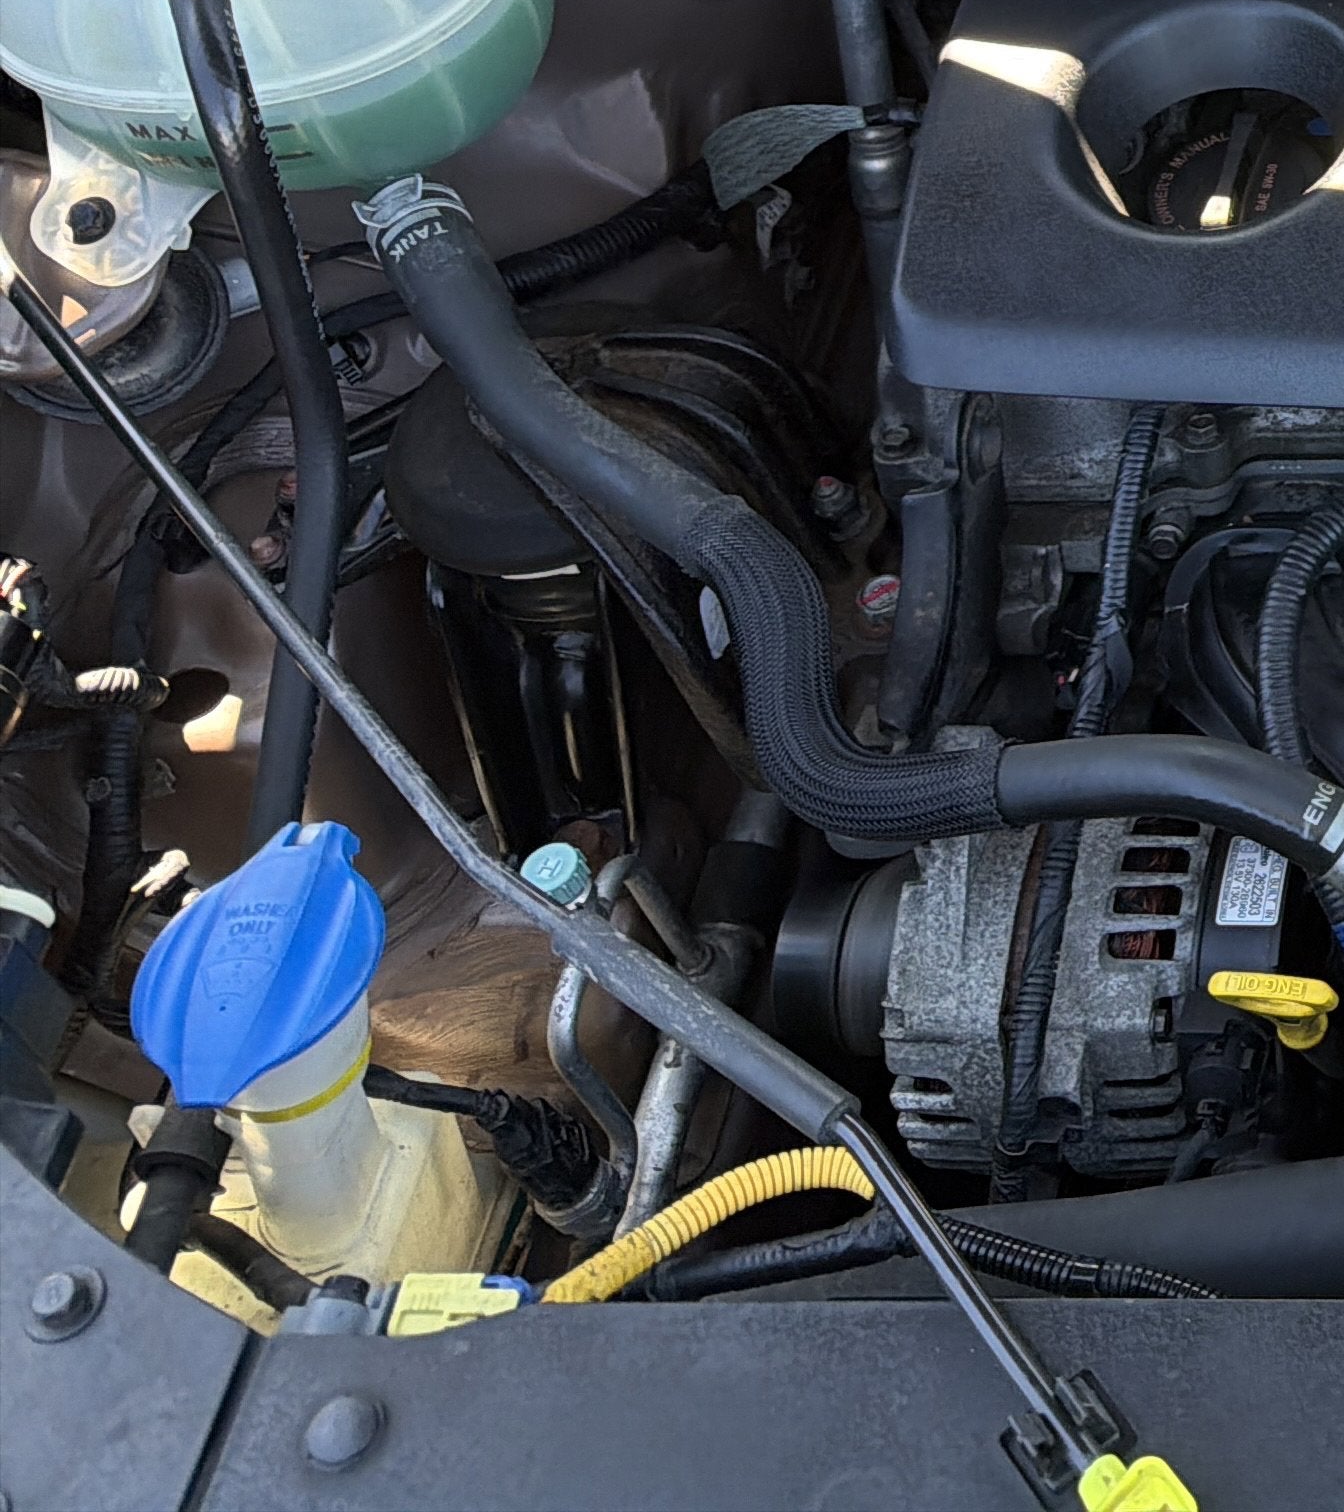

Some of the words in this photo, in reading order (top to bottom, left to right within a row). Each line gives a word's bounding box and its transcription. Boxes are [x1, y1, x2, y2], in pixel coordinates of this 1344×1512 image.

[125, 121, 198, 142] MAX
[1154, 171, 1175, 225] OWNER'S
[1169, 132, 1230, 169] MANUAL
[1255, 192, 1271, 212] SAE
[388, 221, 449, 265] TANK
[1302, 782, 1337, 826] ENG
[536, 856, 562, 878] H
[228, 919, 276, 937] ONLY
[1229, 975, 1260, 995] OIL
[1263, 977, 1305, 1000] ENG
